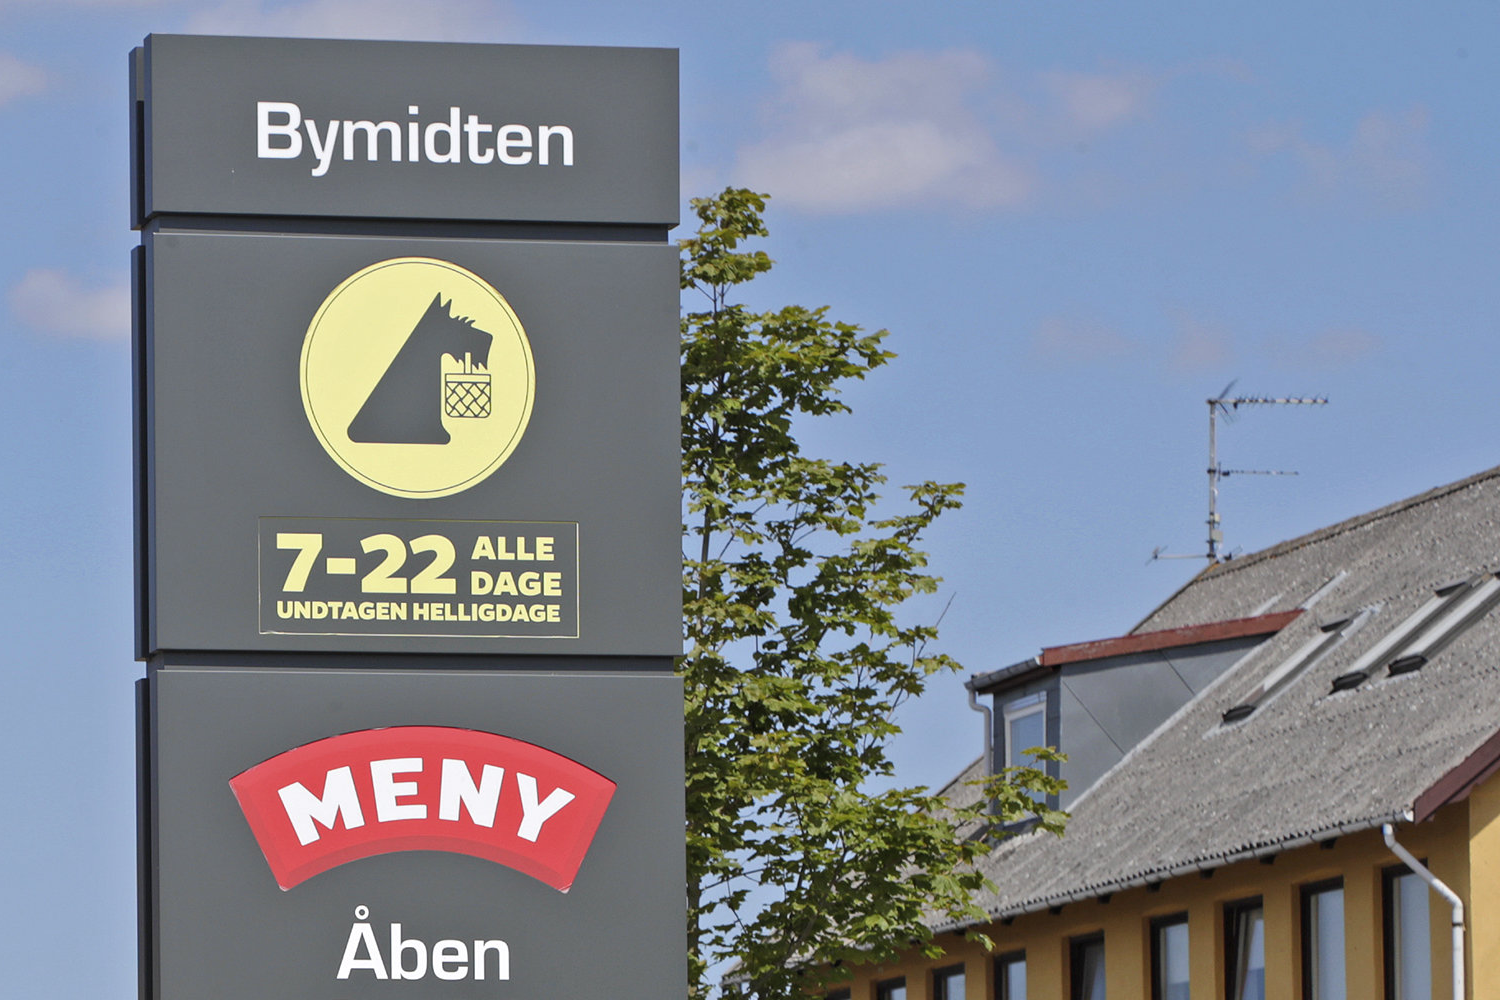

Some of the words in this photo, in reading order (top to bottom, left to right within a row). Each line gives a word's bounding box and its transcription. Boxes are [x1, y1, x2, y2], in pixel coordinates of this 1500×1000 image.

[257, 101, 574, 177] Bymidten
[276, 533, 457, 594] 7-22
[471, 536, 555, 562] ALLE
[277, 601, 407, 621] UNDTAGEN
[413, 602, 560, 623] HELLIGDAGE
[471, 571, 562, 596] DAGE
[277, 757, 575, 846] MENY
[336, 905, 510, 981] Åben
